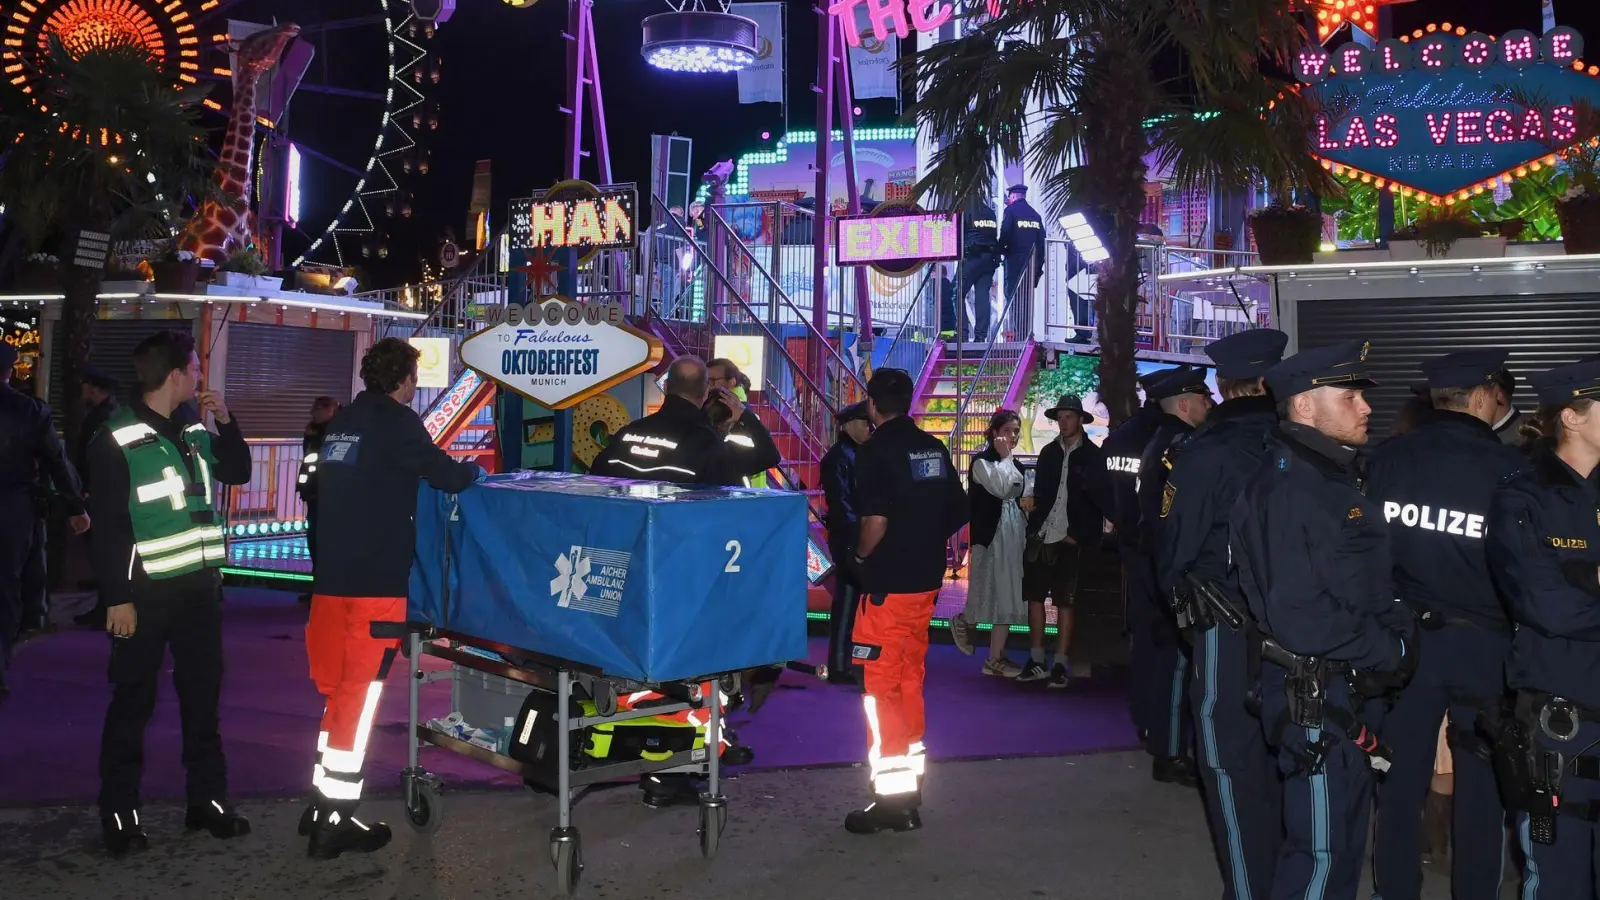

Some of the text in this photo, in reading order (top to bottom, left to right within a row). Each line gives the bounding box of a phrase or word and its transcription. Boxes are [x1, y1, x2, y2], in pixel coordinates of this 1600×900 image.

[1299, 33, 1573, 76] WELCOME
[1317, 105, 1577, 150] LAS VEGAS
[1389, 152, 1496, 172] NEVADA
[531, 200, 631, 247] HAN
[846, 220, 952, 257] EXIT
[488, 306, 619, 322] WELCOME
[497, 329, 593, 346] TO Fabulous
[502, 348, 599, 375] OKTOBERFEST
[531, 378, 567, 386] MUNICH
[909, 452, 928, 460] Medical
[1383, 501, 1488, 539] POLIZE
[1546, 536, 1588, 549] OLIZEI
[725, 539, 741, 573] 2
[600, 565, 627, 579] AICHER
[585, 575, 625, 590] AMBULANZ
[600, 589, 623, 601] UNION
